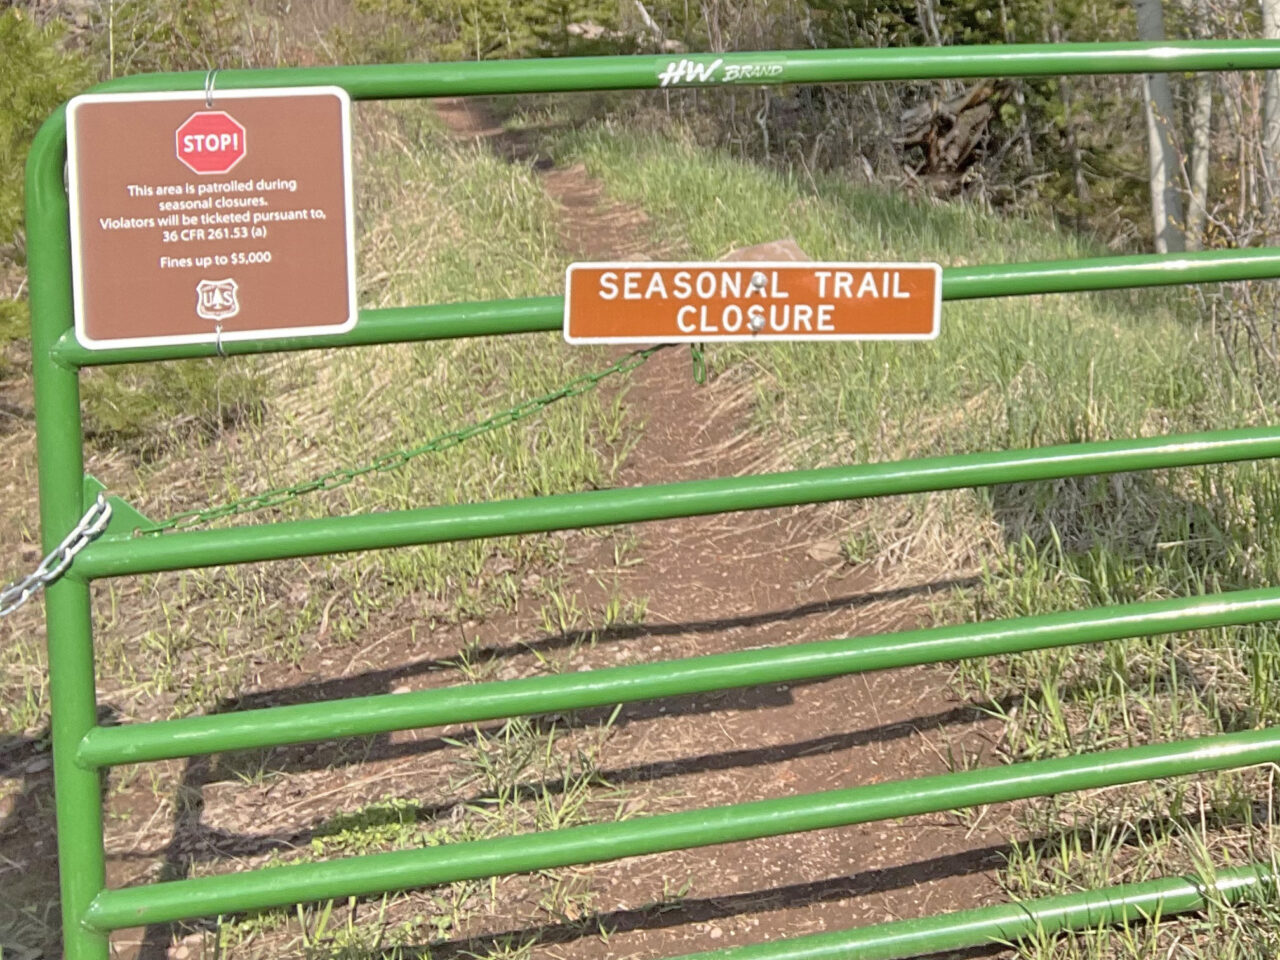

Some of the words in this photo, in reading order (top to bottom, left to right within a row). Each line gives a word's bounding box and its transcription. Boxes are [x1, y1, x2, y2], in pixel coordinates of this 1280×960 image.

[722, 65, 783, 82] BRAND
[183, 133, 238, 152] STOP!
[127, 184, 153, 197] This
[156, 185, 183, 196] area
[185, 182, 195, 194] is
[198, 179, 253, 196] patrolled
[256, 178, 297, 192] during
[159, 197, 212, 211] seasonal
[215, 196, 268, 209] closures.
[100, 216, 155, 230] Violators
[157, 214, 179, 227] will
[182, 214, 198, 226] be
[201, 211, 250, 225] ticketed
[253, 209, 308, 224] pursuant
[310, 209, 326, 220] to,
[163, 230, 178, 242] 36
[180, 229, 205, 241] CFR
[208, 227, 248, 240] 261.53
[251, 225, 267, 238] (a)
[160, 256, 192, 268] Fines
[195, 256, 212, 268] up
[215, 255, 228, 266] to
[230, 251, 272, 265] $5,000
[598, 271, 789, 300] SEASONAL
[815, 271, 910, 299] TRAIL
[677, 304, 835, 333] CLOSURE
